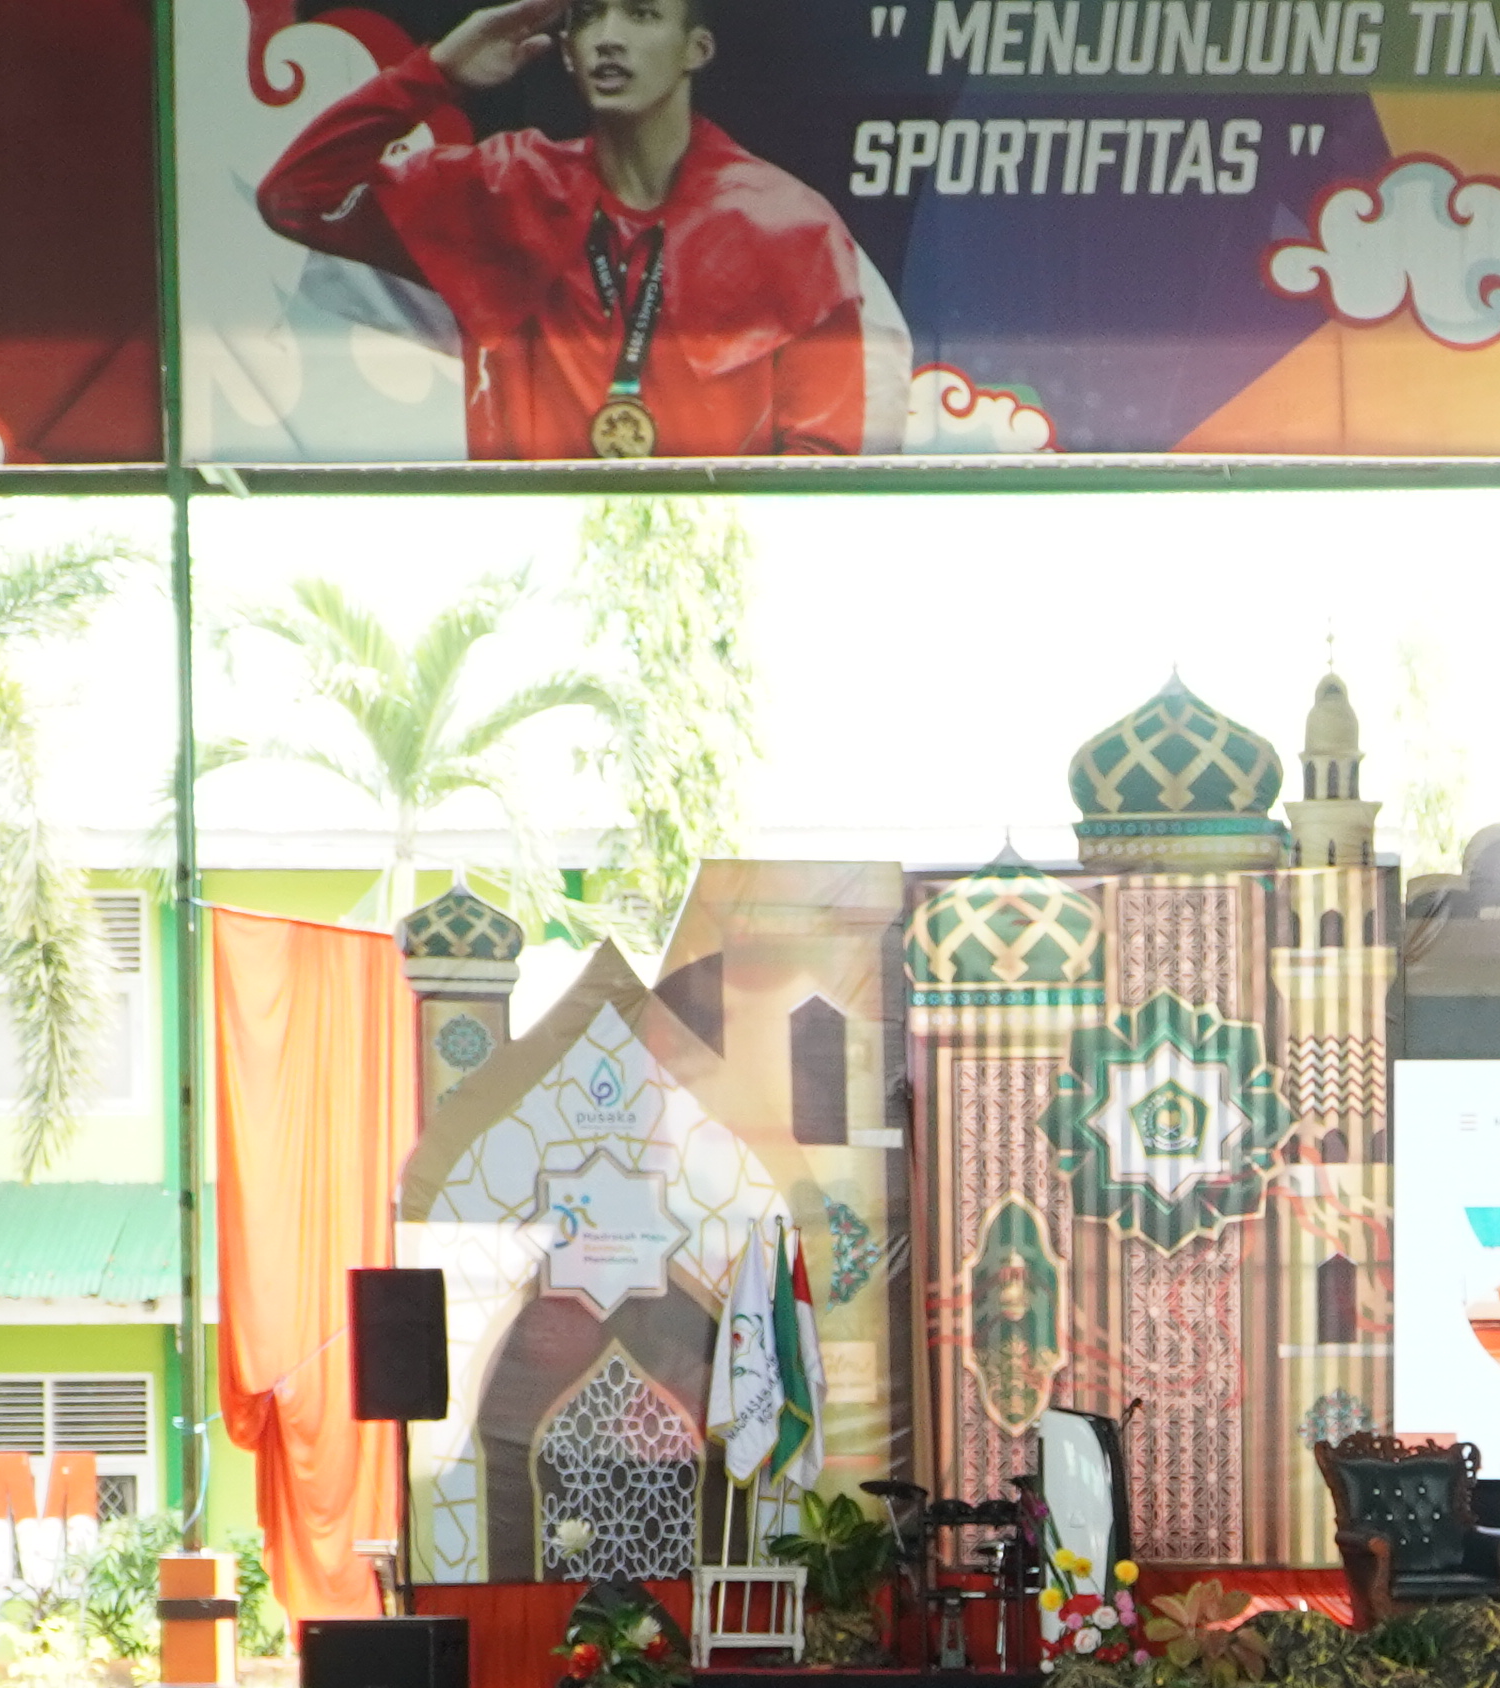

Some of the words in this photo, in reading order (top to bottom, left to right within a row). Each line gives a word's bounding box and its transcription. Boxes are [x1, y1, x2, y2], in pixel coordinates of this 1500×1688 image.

[927, 0, 1384, 75] MENJUNJUNG
[850, 119, 1262, 196] SPORTIFITAS
[576, 1111, 637, 1124] pusaka
